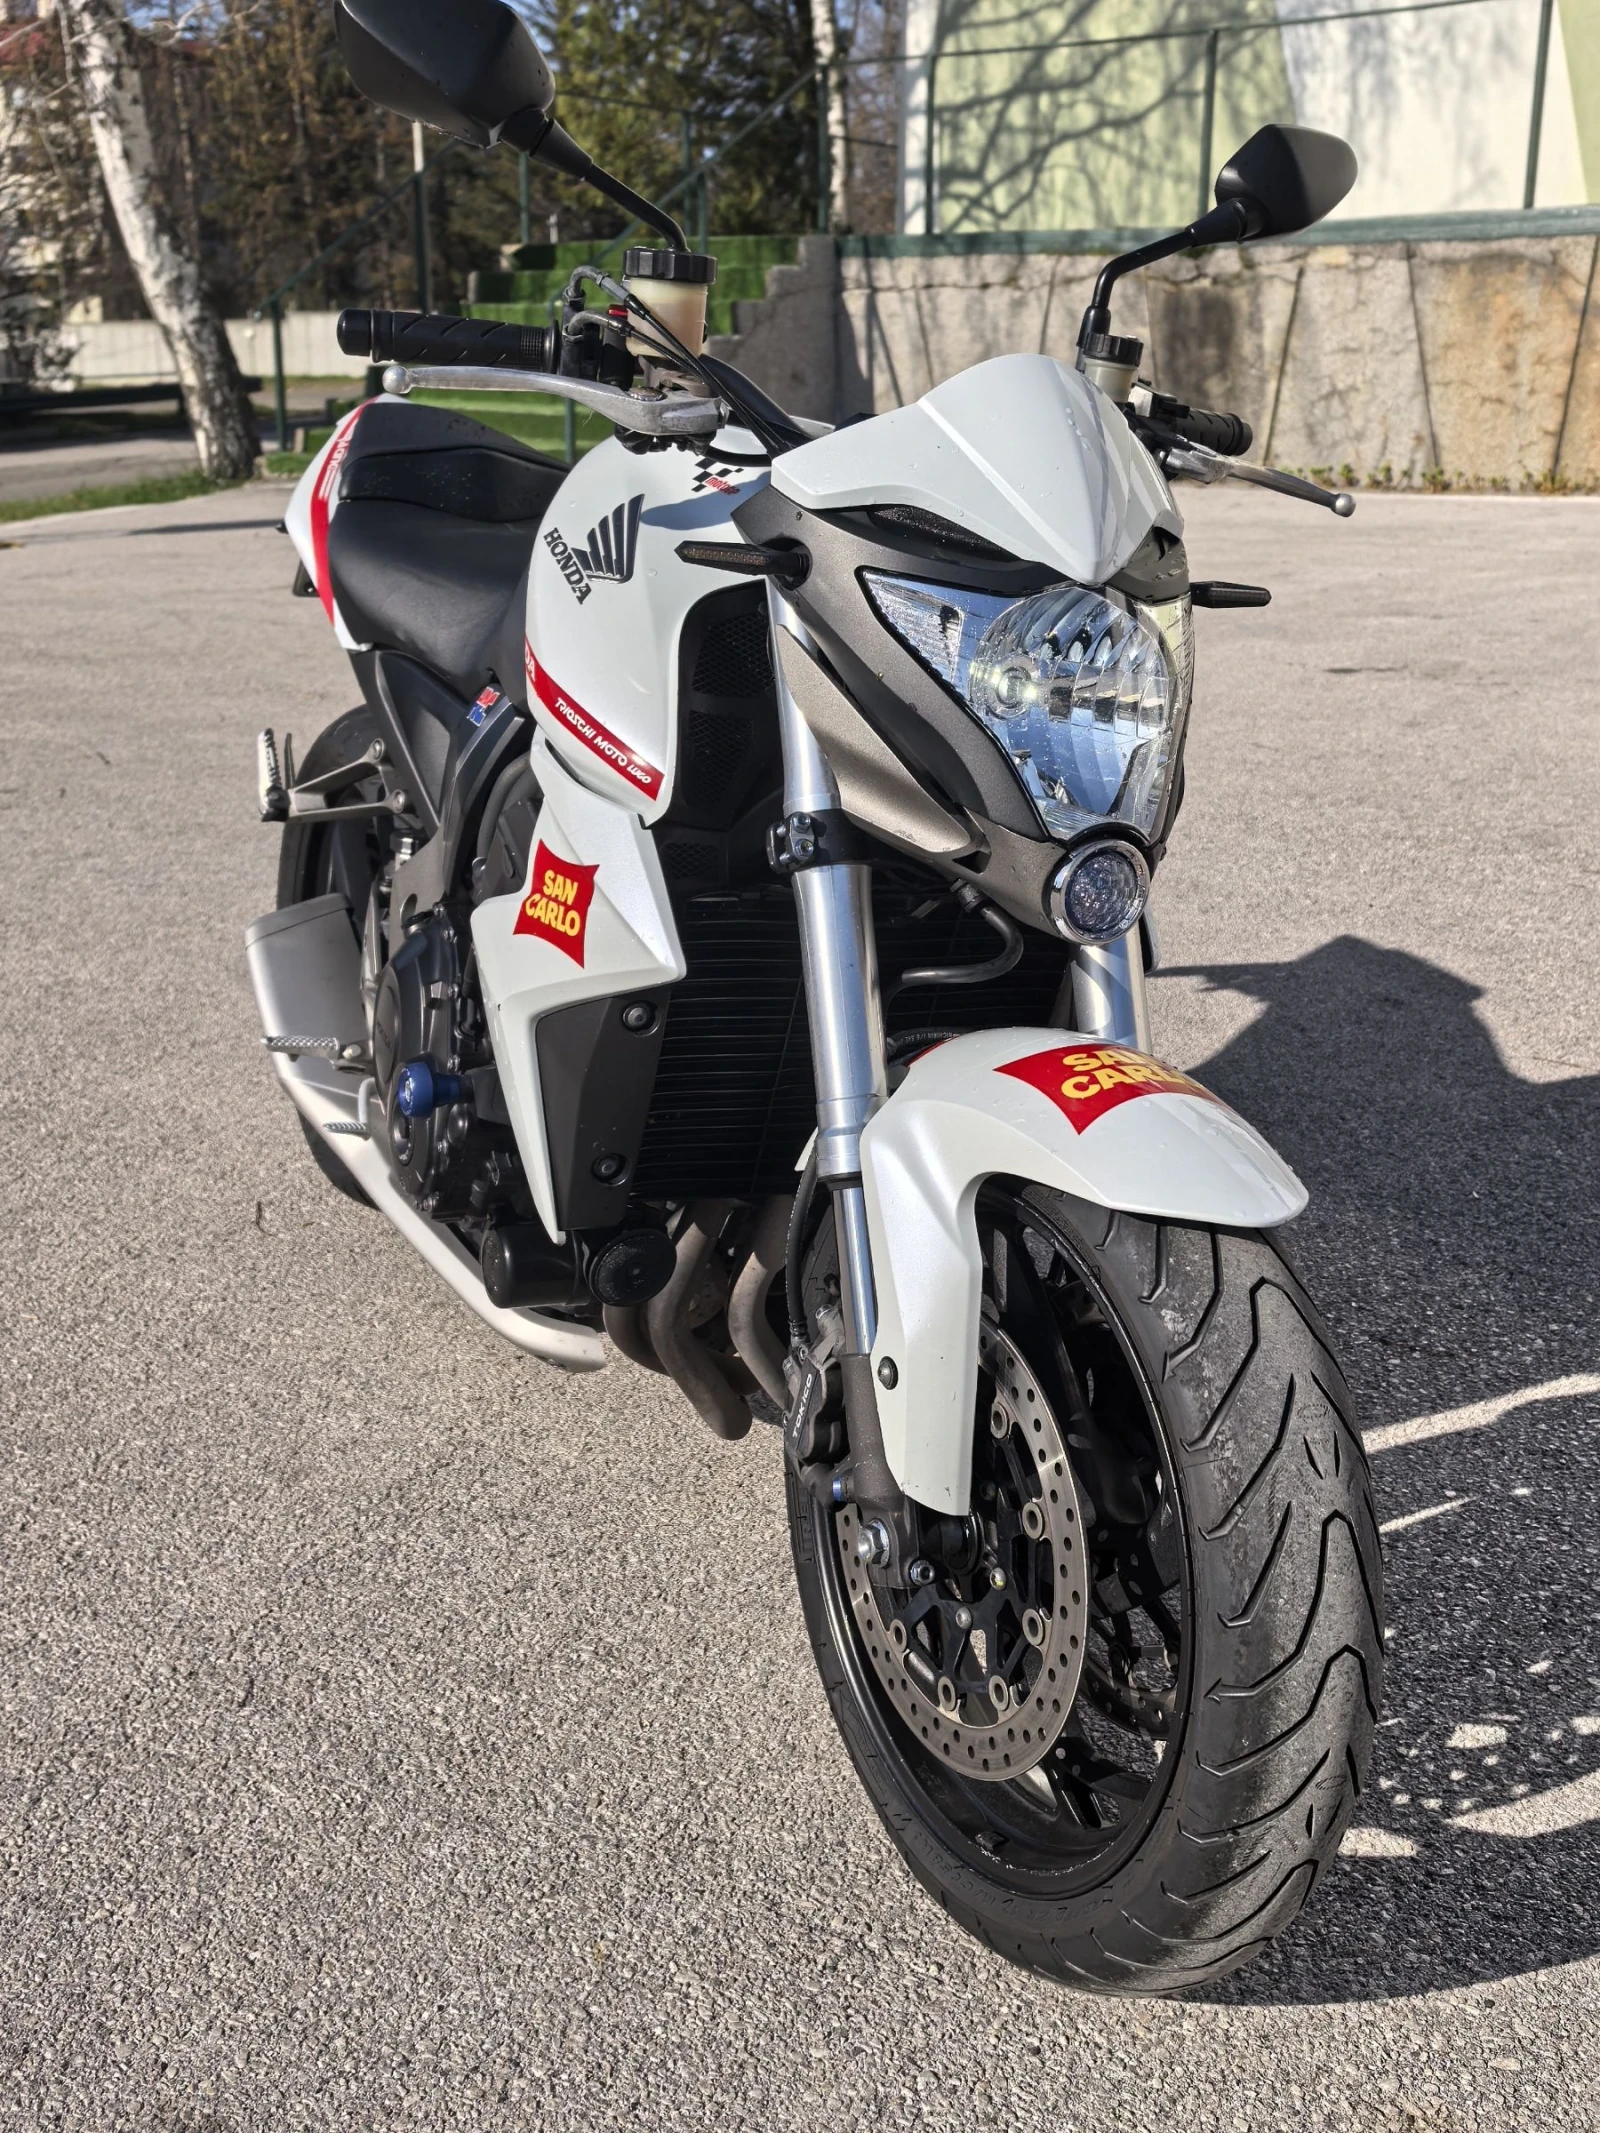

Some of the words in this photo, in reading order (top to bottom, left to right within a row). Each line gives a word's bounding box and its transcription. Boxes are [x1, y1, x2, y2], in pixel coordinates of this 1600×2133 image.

[543, 527, 592, 605] HONDA
[554, 697, 597, 739] TRIOSCHI
[594, 736, 628, 767] MOTO
[525, 893, 581, 937] CARLO
[543, 869, 579, 906] SAN
[792, 1373, 812, 1438] TOKICO
